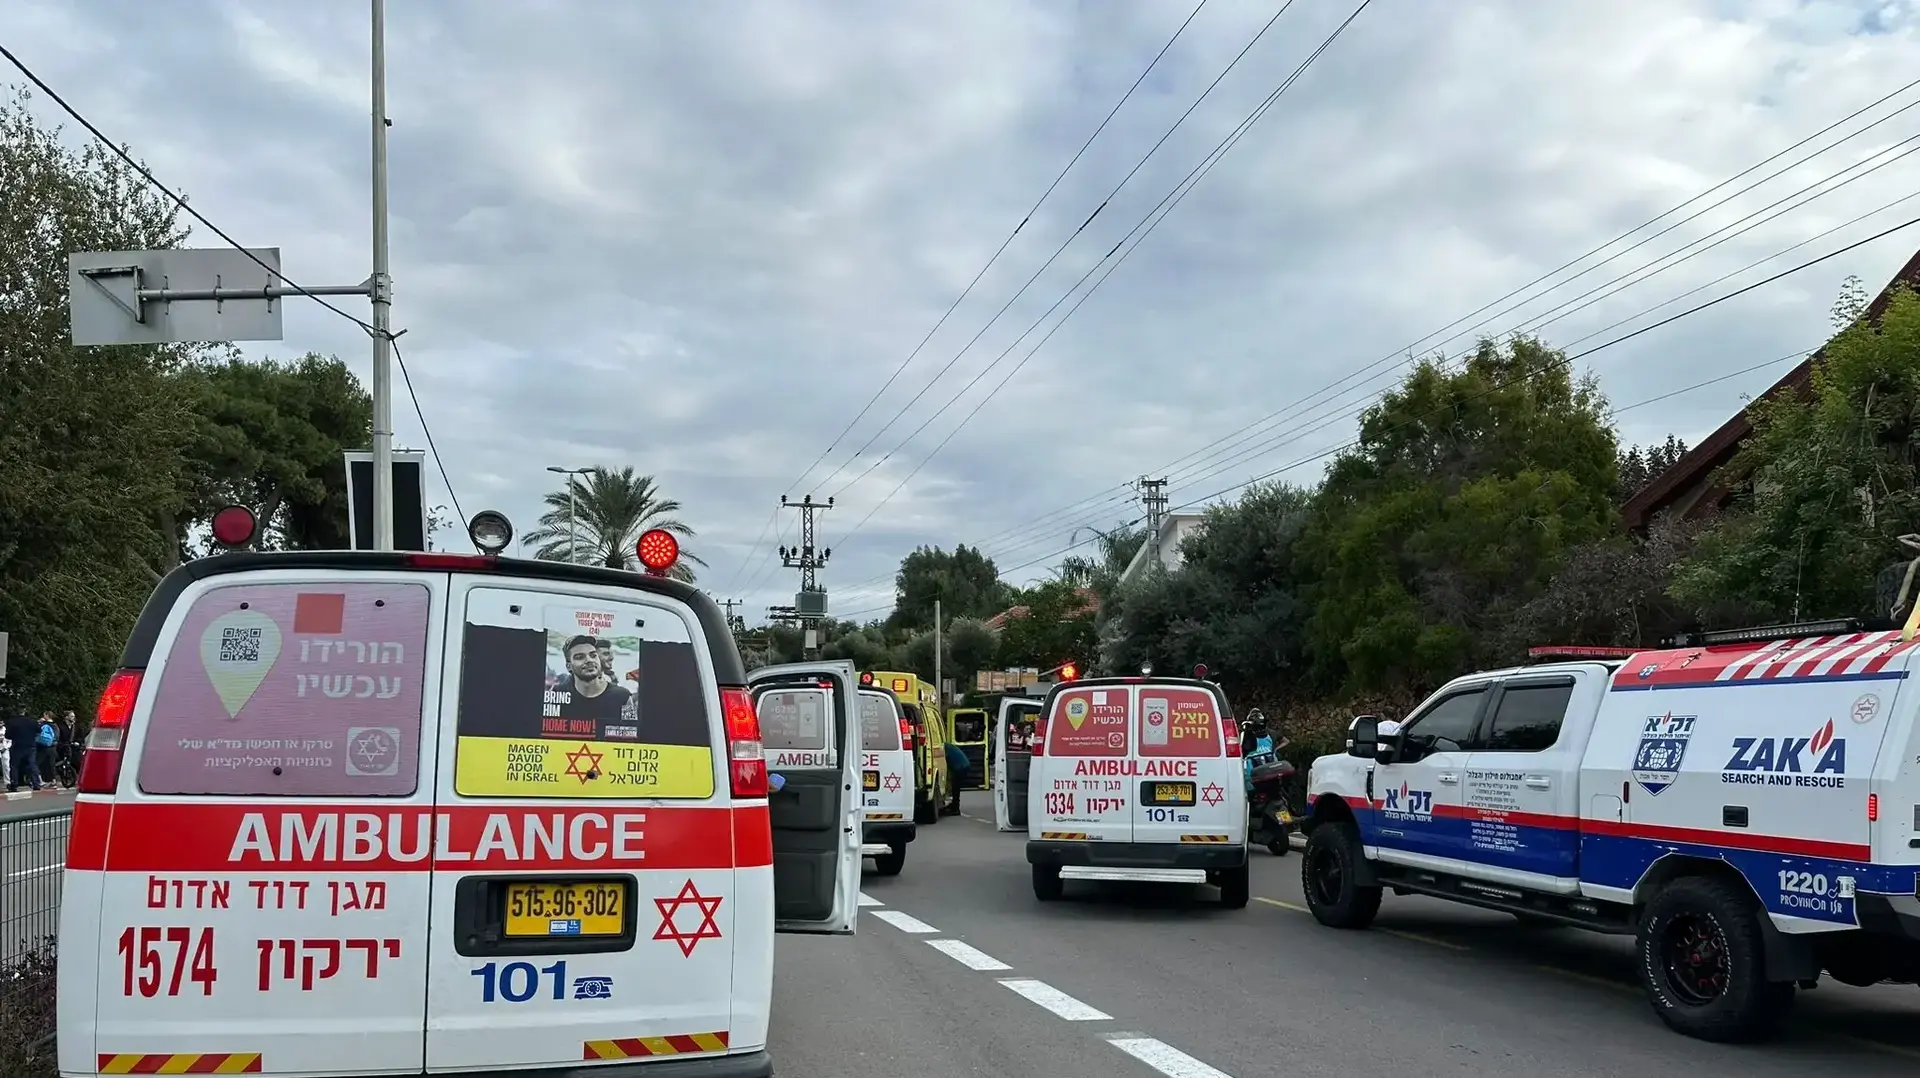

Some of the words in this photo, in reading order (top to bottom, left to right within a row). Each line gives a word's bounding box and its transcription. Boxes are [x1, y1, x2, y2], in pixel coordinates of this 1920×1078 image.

[588, 627, 600, 636] (24)
[299, 639, 405, 664] הורידו
[296, 674, 402, 699] עכשיו
[543, 690, 572, 704] BRING
[542, 703, 561, 717] HIM
[1093, 705, 1124, 714] הורידו
[1093, 716, 1124, 725] עכשיו
[1171, 709, 1210, 725] מציל
[542, 718, 568, 732] HOME
[570, 718, 596, 734] NOW!
[1171, 725, 1210, 739] חיים
[177, 738, 203, 750] שלי
[285, 739, 299, 750] או
[508, 744, 550, 755] MAGEN
[507, 753, 543, 763] DAVID
[613, 747, 637, 759] דוד
[638, 750, 659, 761] מגן
[204, 754, 282, 770] האפליקציות
[507, 762, 543, 773] ADOM
[627, 761, 659, 772] אדום
[1074, 759, 1198, 777] AMBULANCE
[506, 771, 519, 782] IN
[522, 772, 560, 783] ISRAEL
[608, 771, 658, 785] בישראל
[1053, 778, 1077, 790] אדום
[1721, 772, 1765, 786] SEARCH
[1767, 774, 1792, 787] AND
[1795, 775, 1845, 788] RESCUE
[1082, 779, 1099, 790] דוד
[1103, 779, 1121, 792] מגן
[1044, 792, 1075, 815] 1334
[1086, 797, 1125, 815] ירקון
[1145, 808, 1176, 822] 101
[228, 812, 646, 862] AMBULANCE
[1778, 869, 1828, 896] 1220
[147, 874, 231, 910] אדום
[248, 880, 310, 910] דוד
[327, 880, 387, 916] מגן
[1780, 894, 1827, 911] PROVISION
[118, 926, 217, 998] 1574
[256, 938, 402, 992] ירקון
[471, 960, 567, 1003] 101
